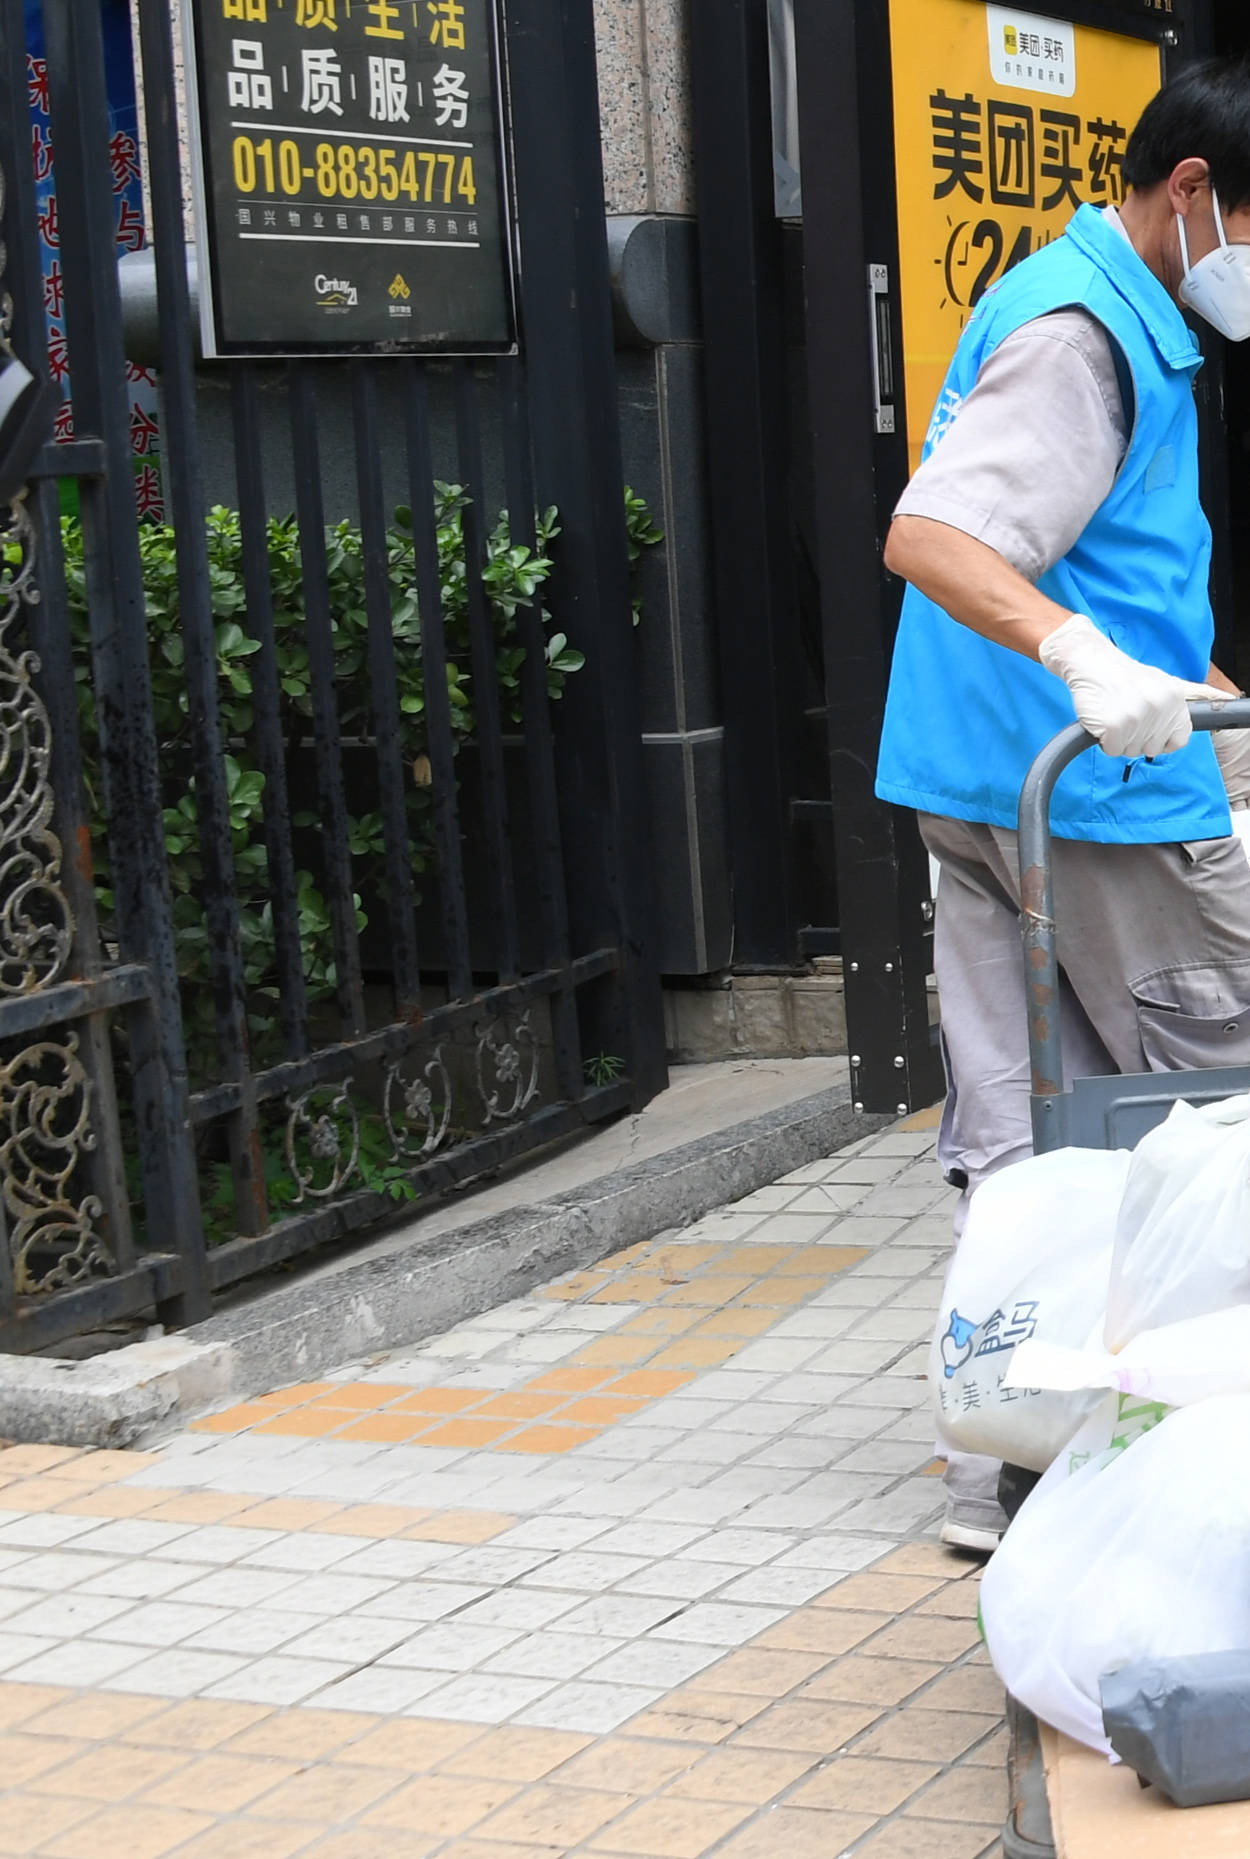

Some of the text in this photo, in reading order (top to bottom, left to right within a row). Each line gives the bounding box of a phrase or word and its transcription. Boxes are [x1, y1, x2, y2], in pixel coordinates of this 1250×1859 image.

[232, 136, 476, 205] 010-88354774
[929, 88, 1127, 212] 美团买药
[974, 1300, 1041, 1357] 盒马
